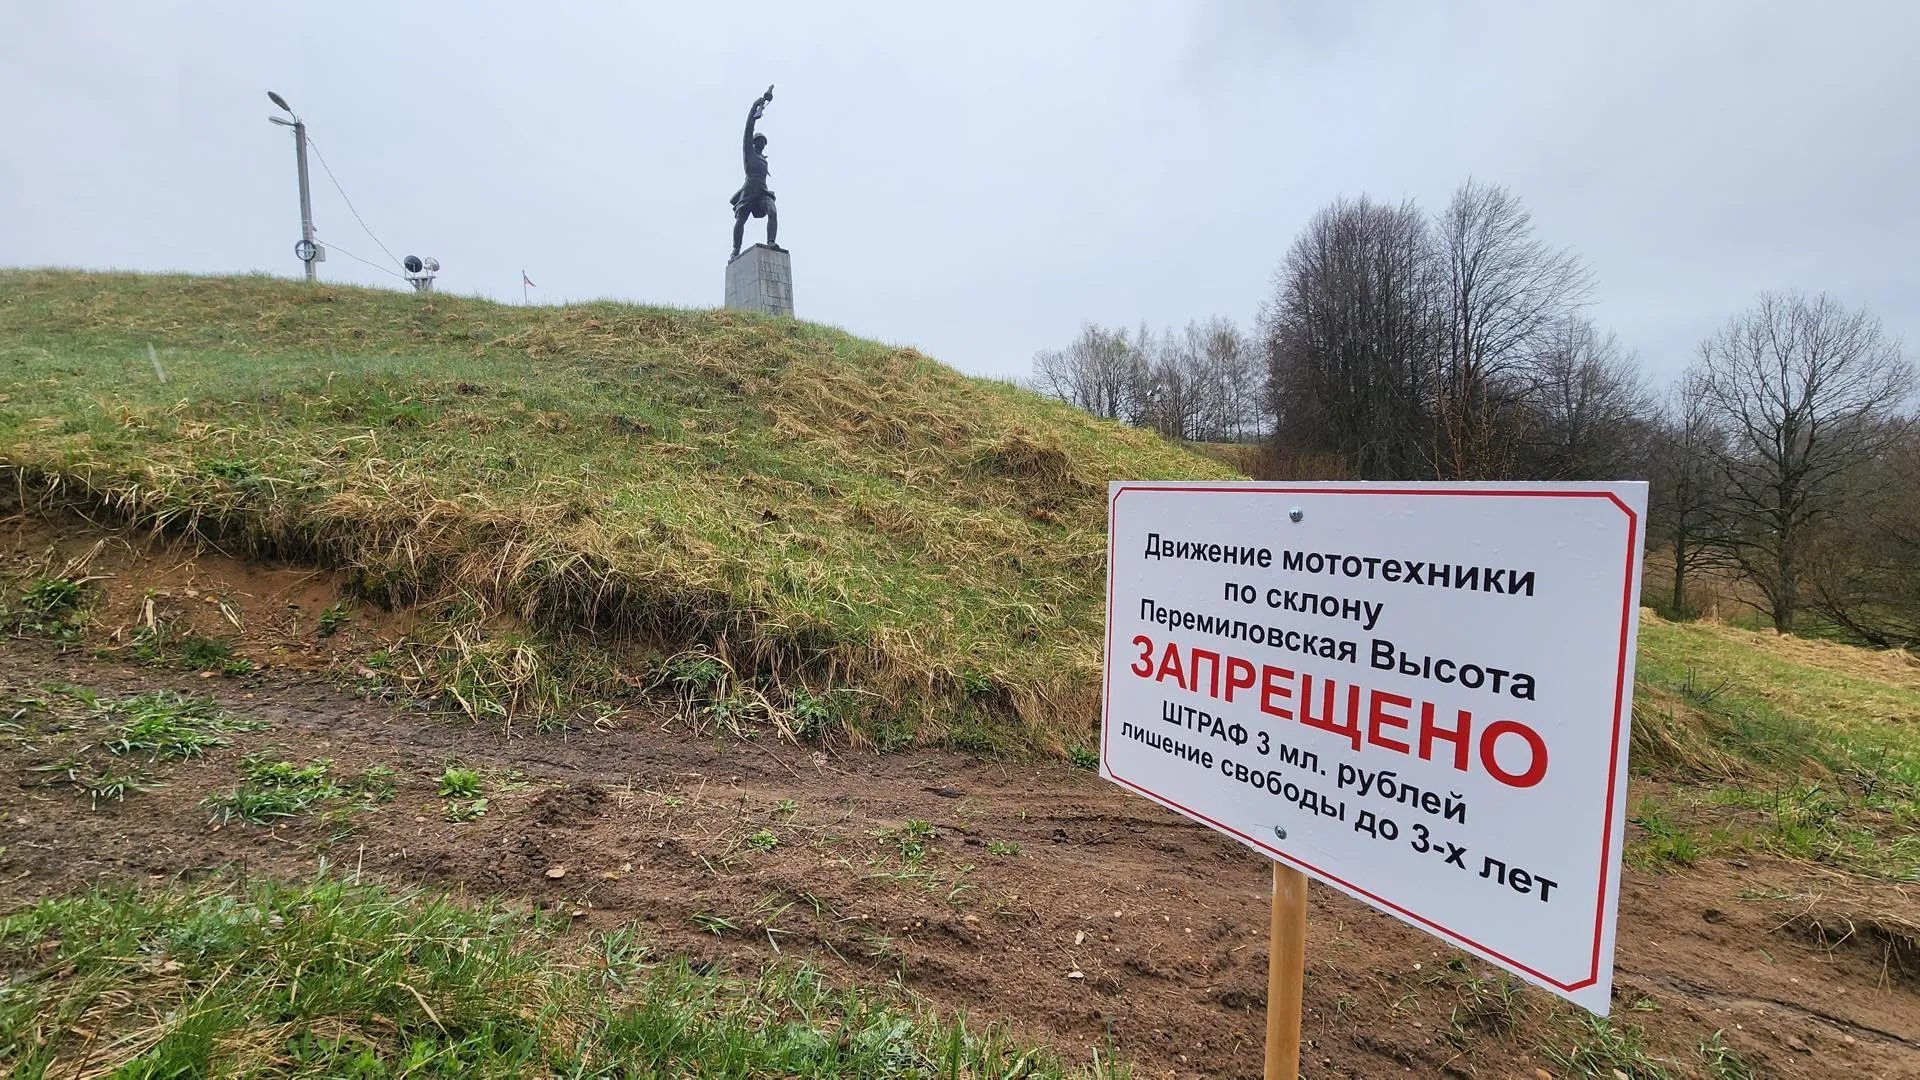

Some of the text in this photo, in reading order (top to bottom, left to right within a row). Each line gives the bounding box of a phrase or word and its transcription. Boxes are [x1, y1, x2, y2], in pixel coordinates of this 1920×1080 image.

[1144, 532, 1536, 597] Движение мототехники
[1224, 582, 1384, 631] по склону
[1140, 598, 1536, 702] Перемиловская Высота
[1130, 634, 1549, 789] ЗАПРЕЩЕНО
[1162, 699, 1467, 825] ШТРАФ 3 мл. рублей
[1120, 721, 1558, 903] лишение свободы до 3-х лет
